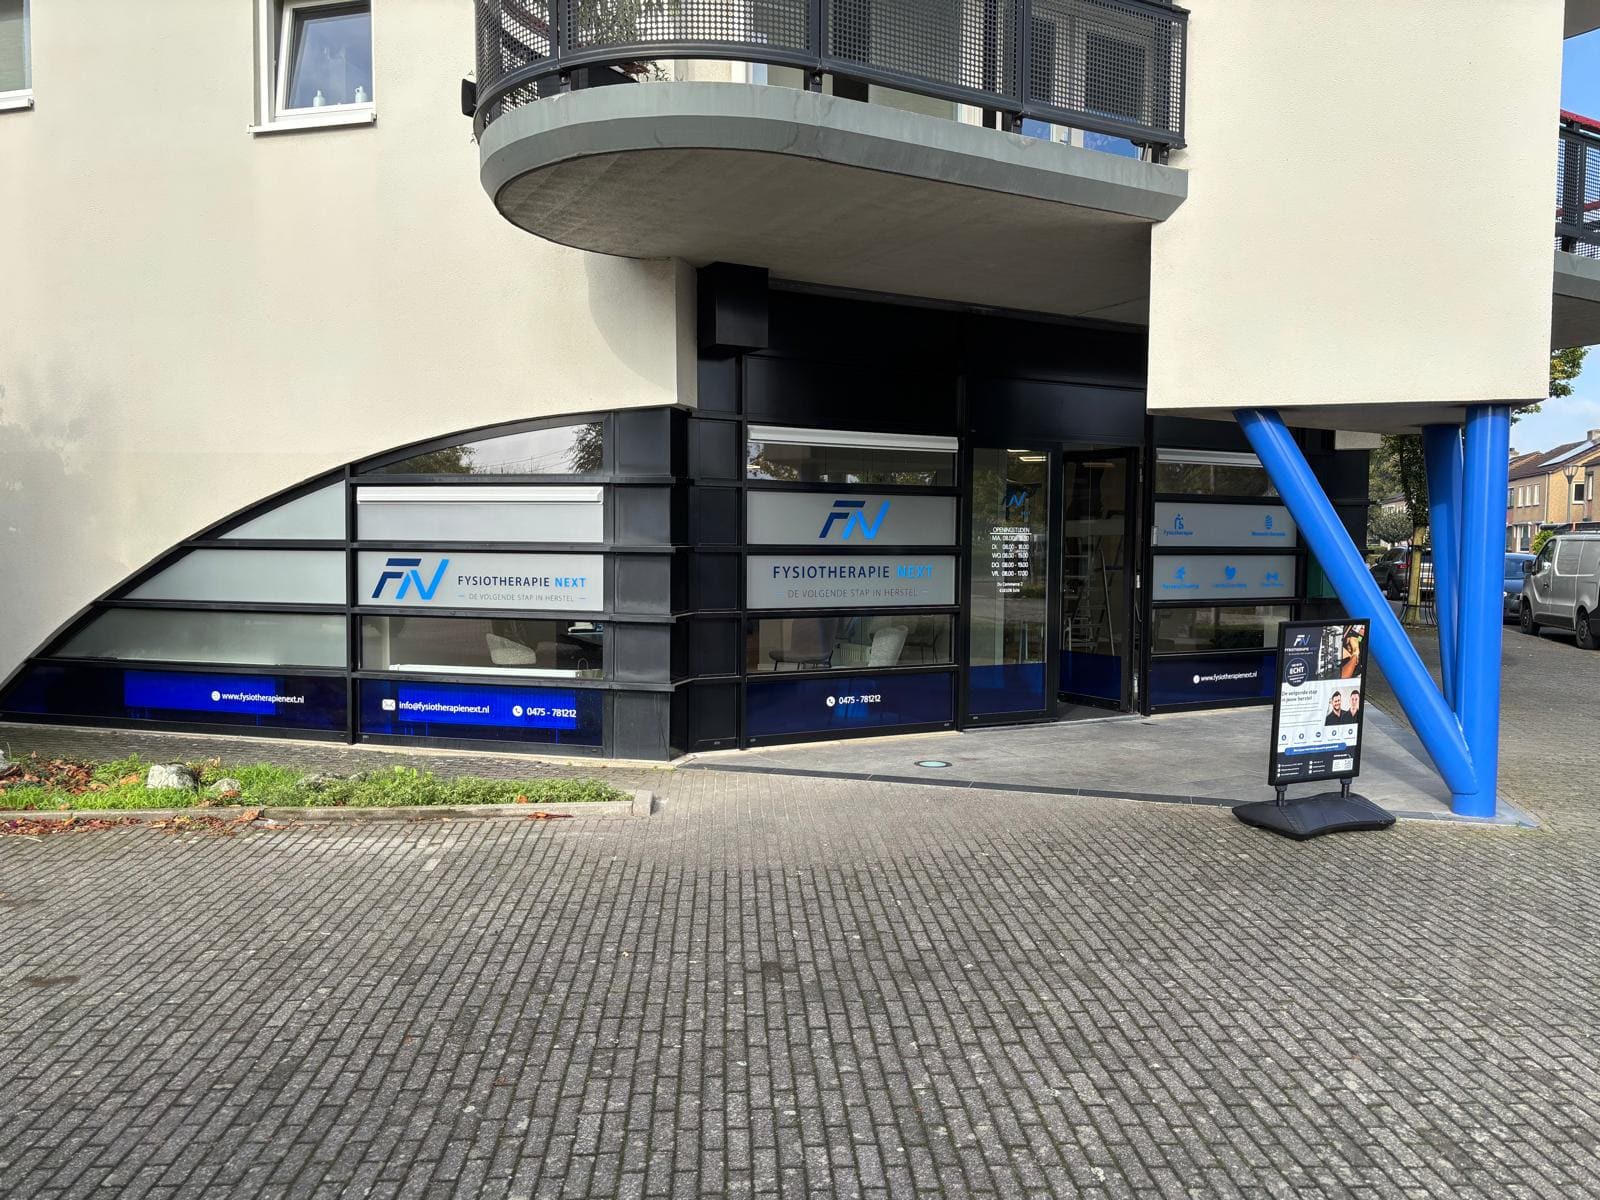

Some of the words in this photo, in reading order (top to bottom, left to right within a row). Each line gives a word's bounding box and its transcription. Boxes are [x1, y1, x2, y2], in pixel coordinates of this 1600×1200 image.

[773, 565, 890, 579] FYSIOTHERAPIE
[896, 565, 933, 578] NEXT
[458, 575, 550, 587] FYSIOTHERAPIE
[554, 577, 586, 588] NEXT
[480, 593, 515, 601] VOLGENDE
[517, 593, 534, 601] STAP
[545, 594, 574, 602] HERSTEL
[787, 589, 799, 599] DE
[802, 588, 848, 598] VOLGENDE
[850, 588, 870, 597] STAP
[872, 588, 881, 597] IN
[884, 587, 918, 597] HERSTEL
[221, 692, 305, 704] www.fysiotherapienext.nl
[838, 696, 855, 705] 0475
[399, 701, 490, 715] info@fysiotherapienext.nl
[526, 707, 546, 716] 0475
[551, 708, 577, 718] 781212
